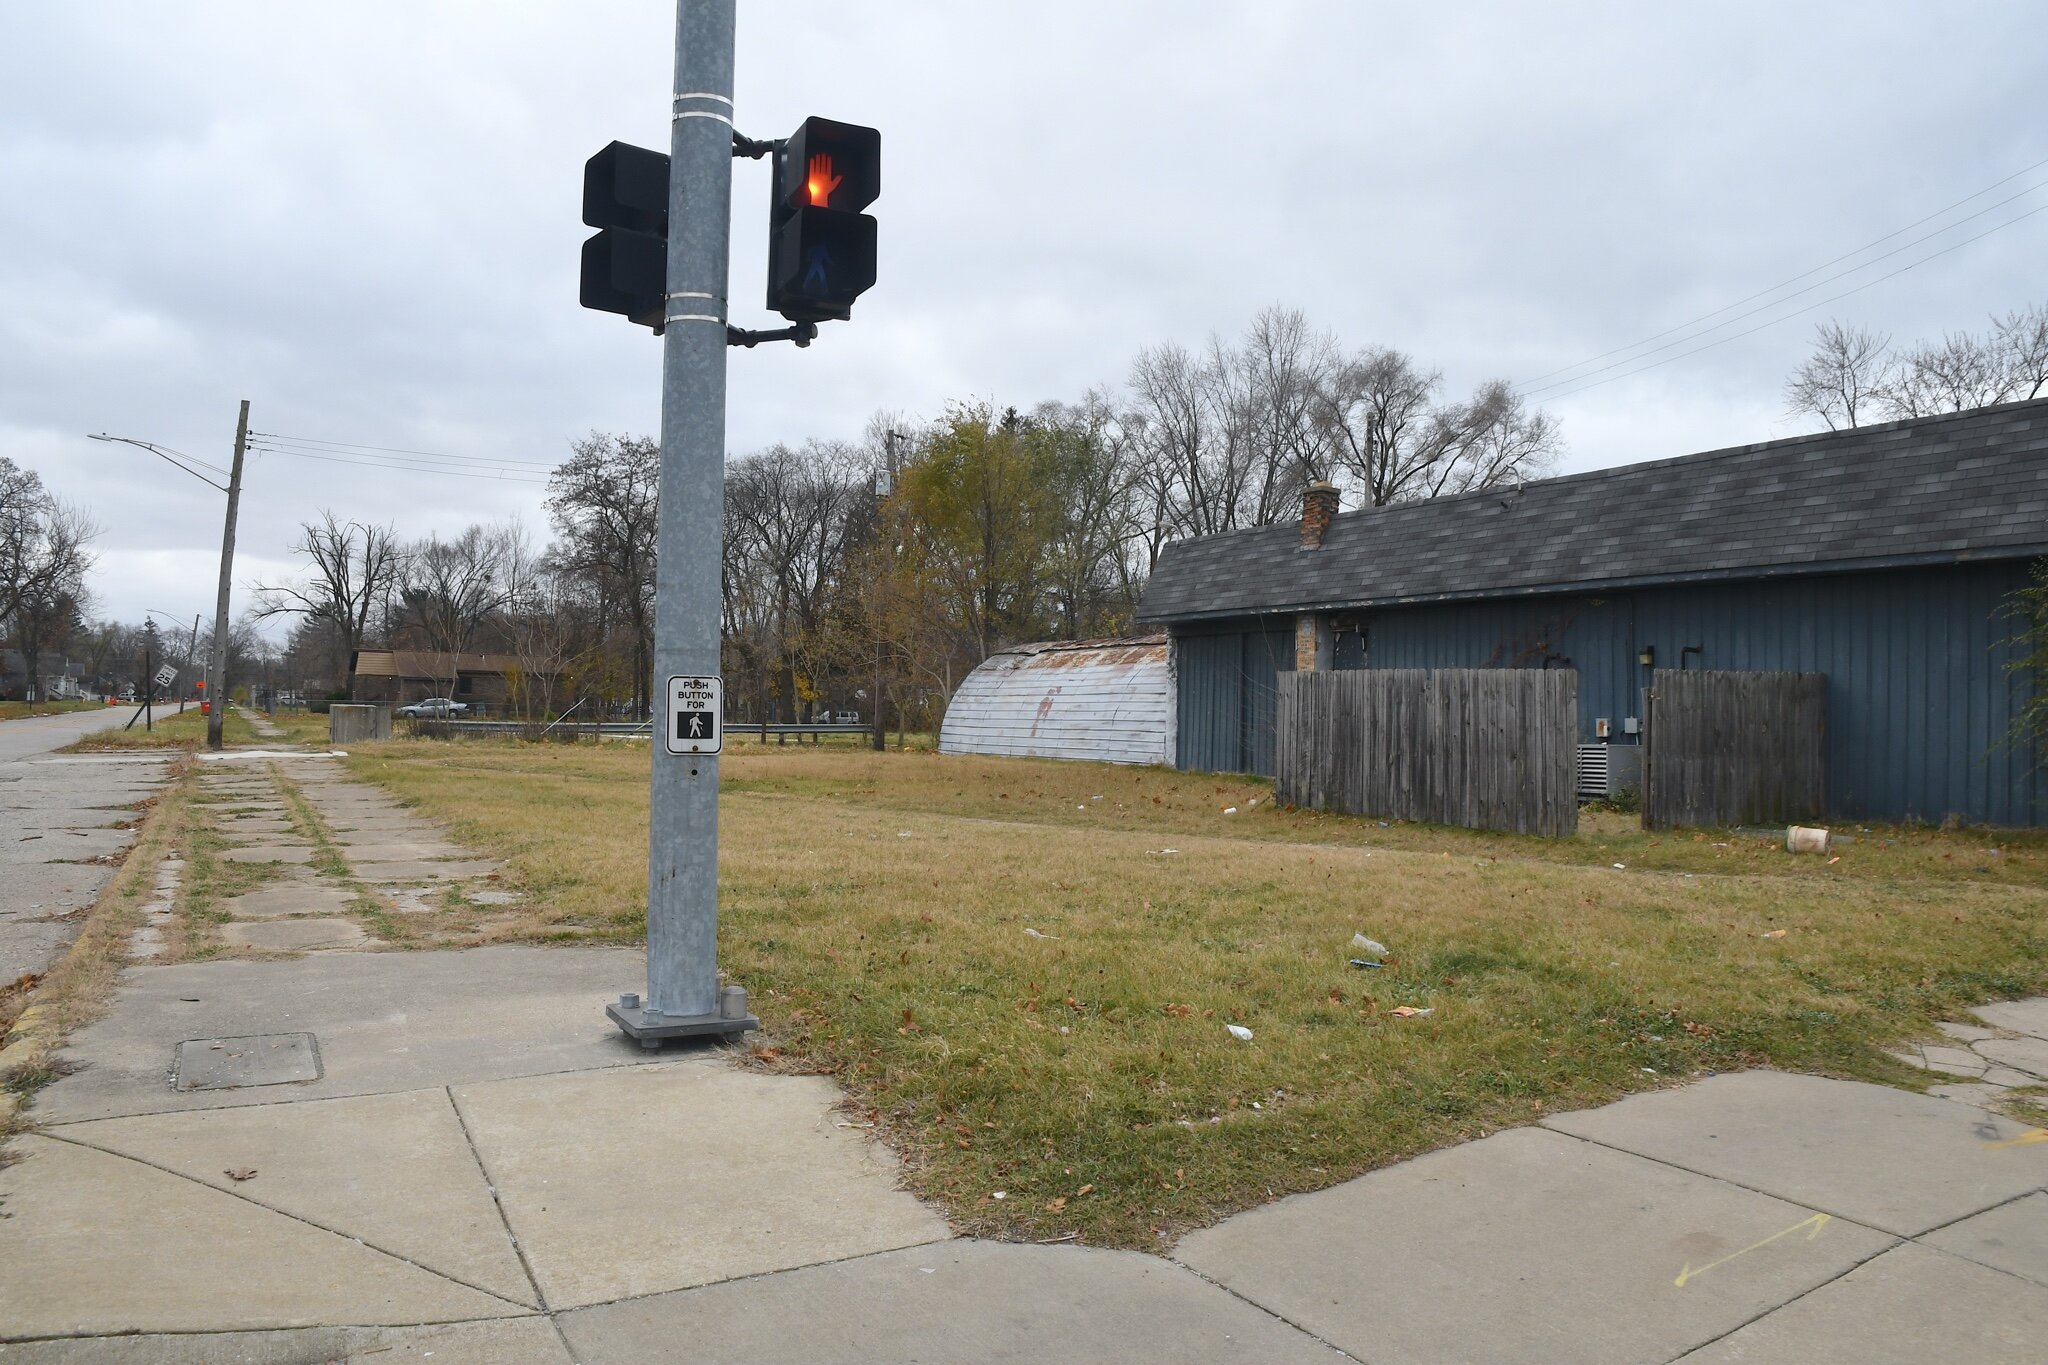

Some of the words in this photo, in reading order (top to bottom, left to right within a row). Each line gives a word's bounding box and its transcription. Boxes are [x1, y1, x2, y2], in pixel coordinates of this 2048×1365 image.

[156, 673, 171, 685] 25
[683, 681, 709, 689] PUSH
[678, 691, 713, 699] BUTTON
[686, 701, 705, 709] FOR
